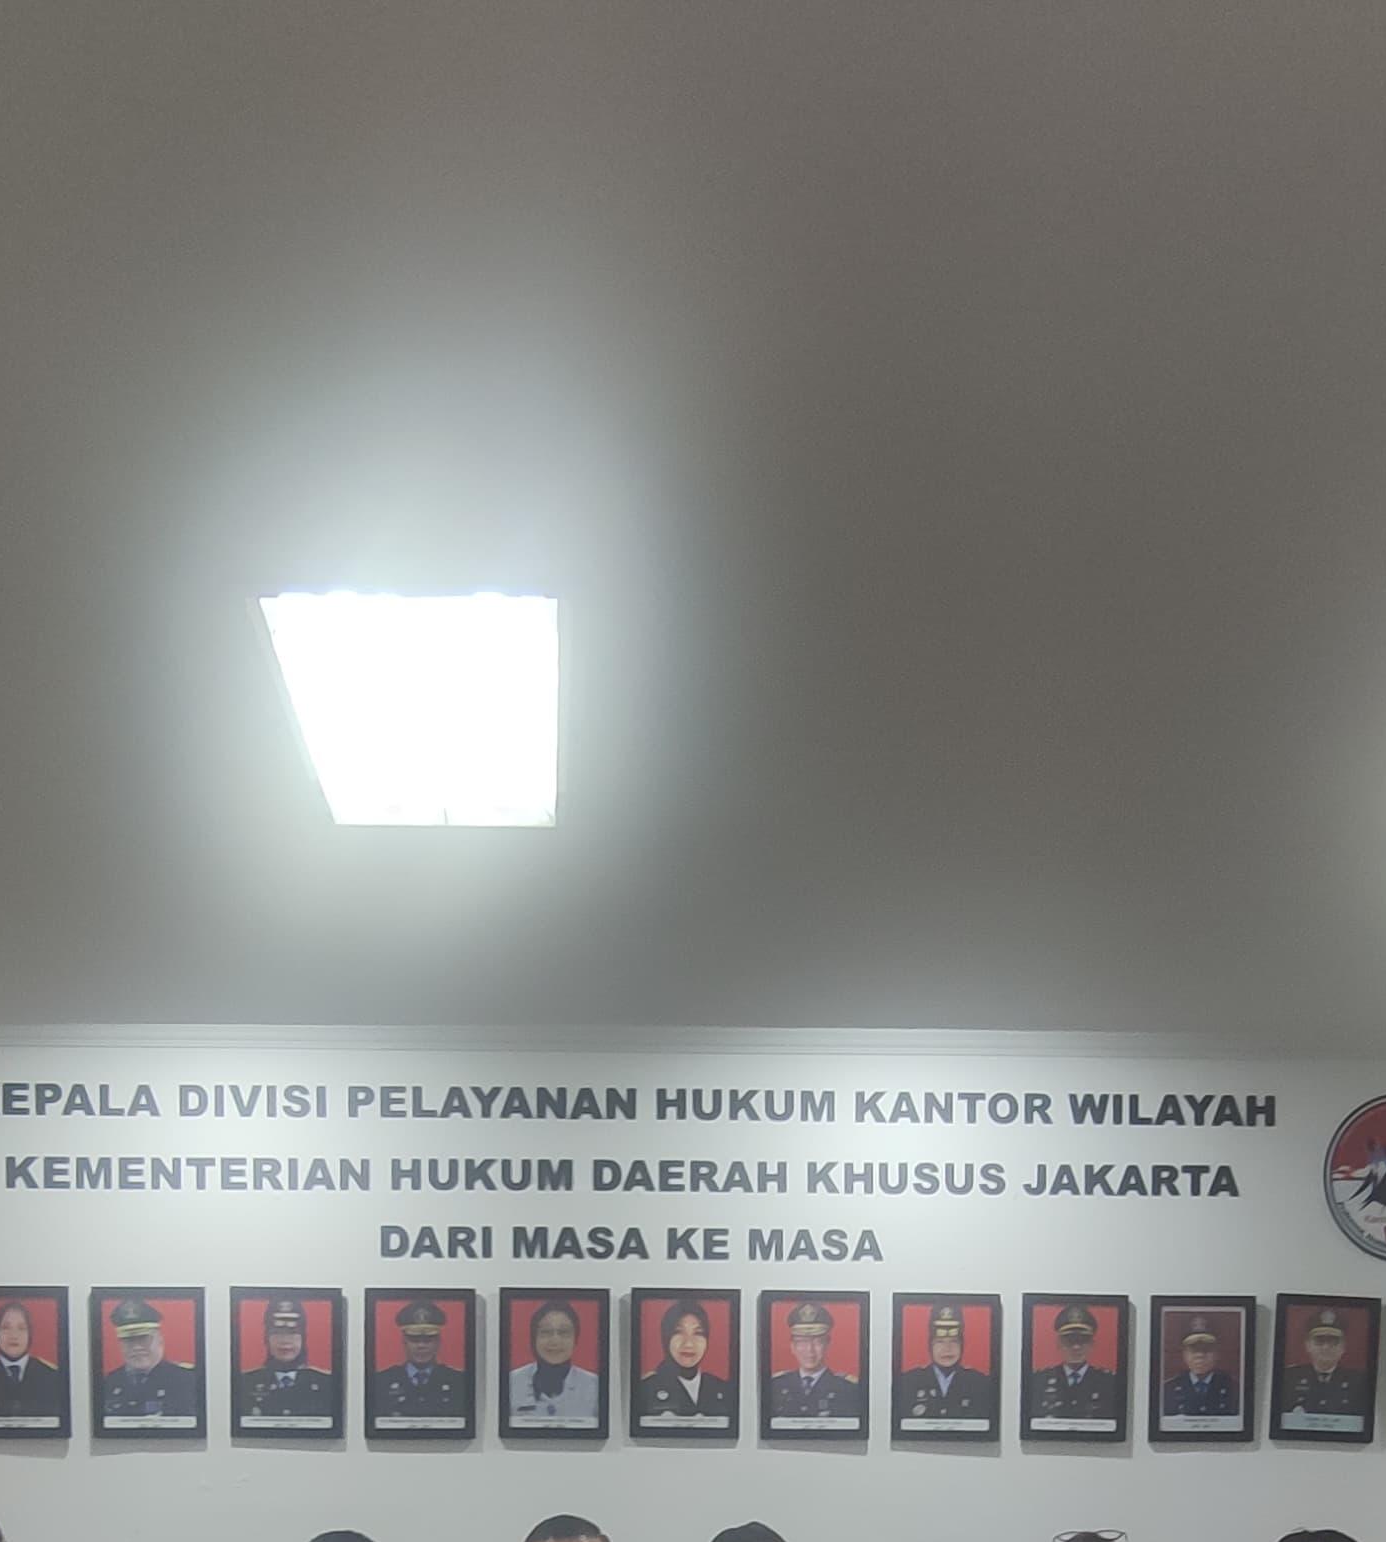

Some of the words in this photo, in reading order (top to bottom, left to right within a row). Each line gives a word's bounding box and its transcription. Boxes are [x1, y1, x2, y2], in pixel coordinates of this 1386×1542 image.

[178, 1084, 327, 1118] DIVISI
[347, 1085, 638, 1121] PELAYANAN
[655, 1087, 836, 1123] HUKUM
[854, 1090, 1054, 1125] KANTOR
[1067, 1093, 1277, 1128] WILAYAH
[4, 1155, 370, 1191] KEMENTERIAN
[390, 1157, 575, 1192] HUKUM
[592, 1158, 788, 1194] DAERAH
[807, 1161, 1006, 1196] KHUSUS
[1022, 1163, 1241, 1198] JAKARTA
[380, 1225, 493, 1260] DARI
[511, 1225, 651, 1261] MASA
[666, 1227, 730, 1261] KE
[748, 1228, 884, 1262] MASA
